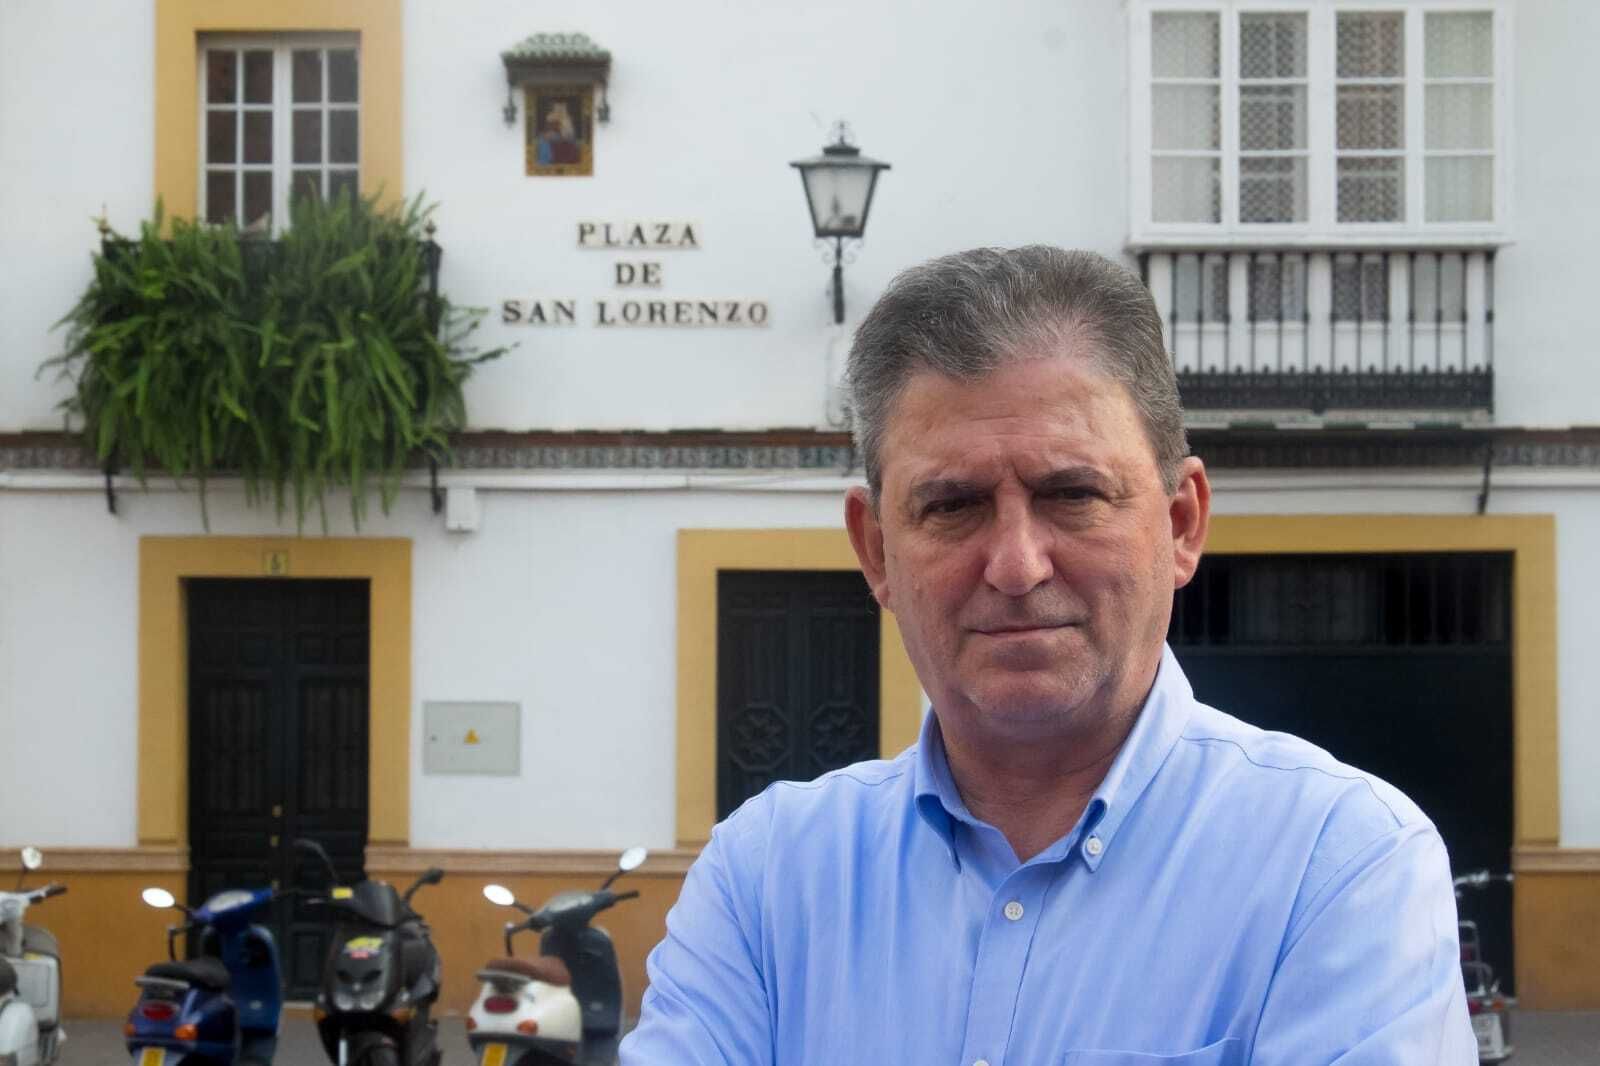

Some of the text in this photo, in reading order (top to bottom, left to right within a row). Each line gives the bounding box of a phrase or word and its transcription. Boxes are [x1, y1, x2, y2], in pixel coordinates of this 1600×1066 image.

[578, 222, 698, 246] PLAZA
[615, 262, 661, 285] DE
[502, 301, 768, 325] SAN LORENZO
